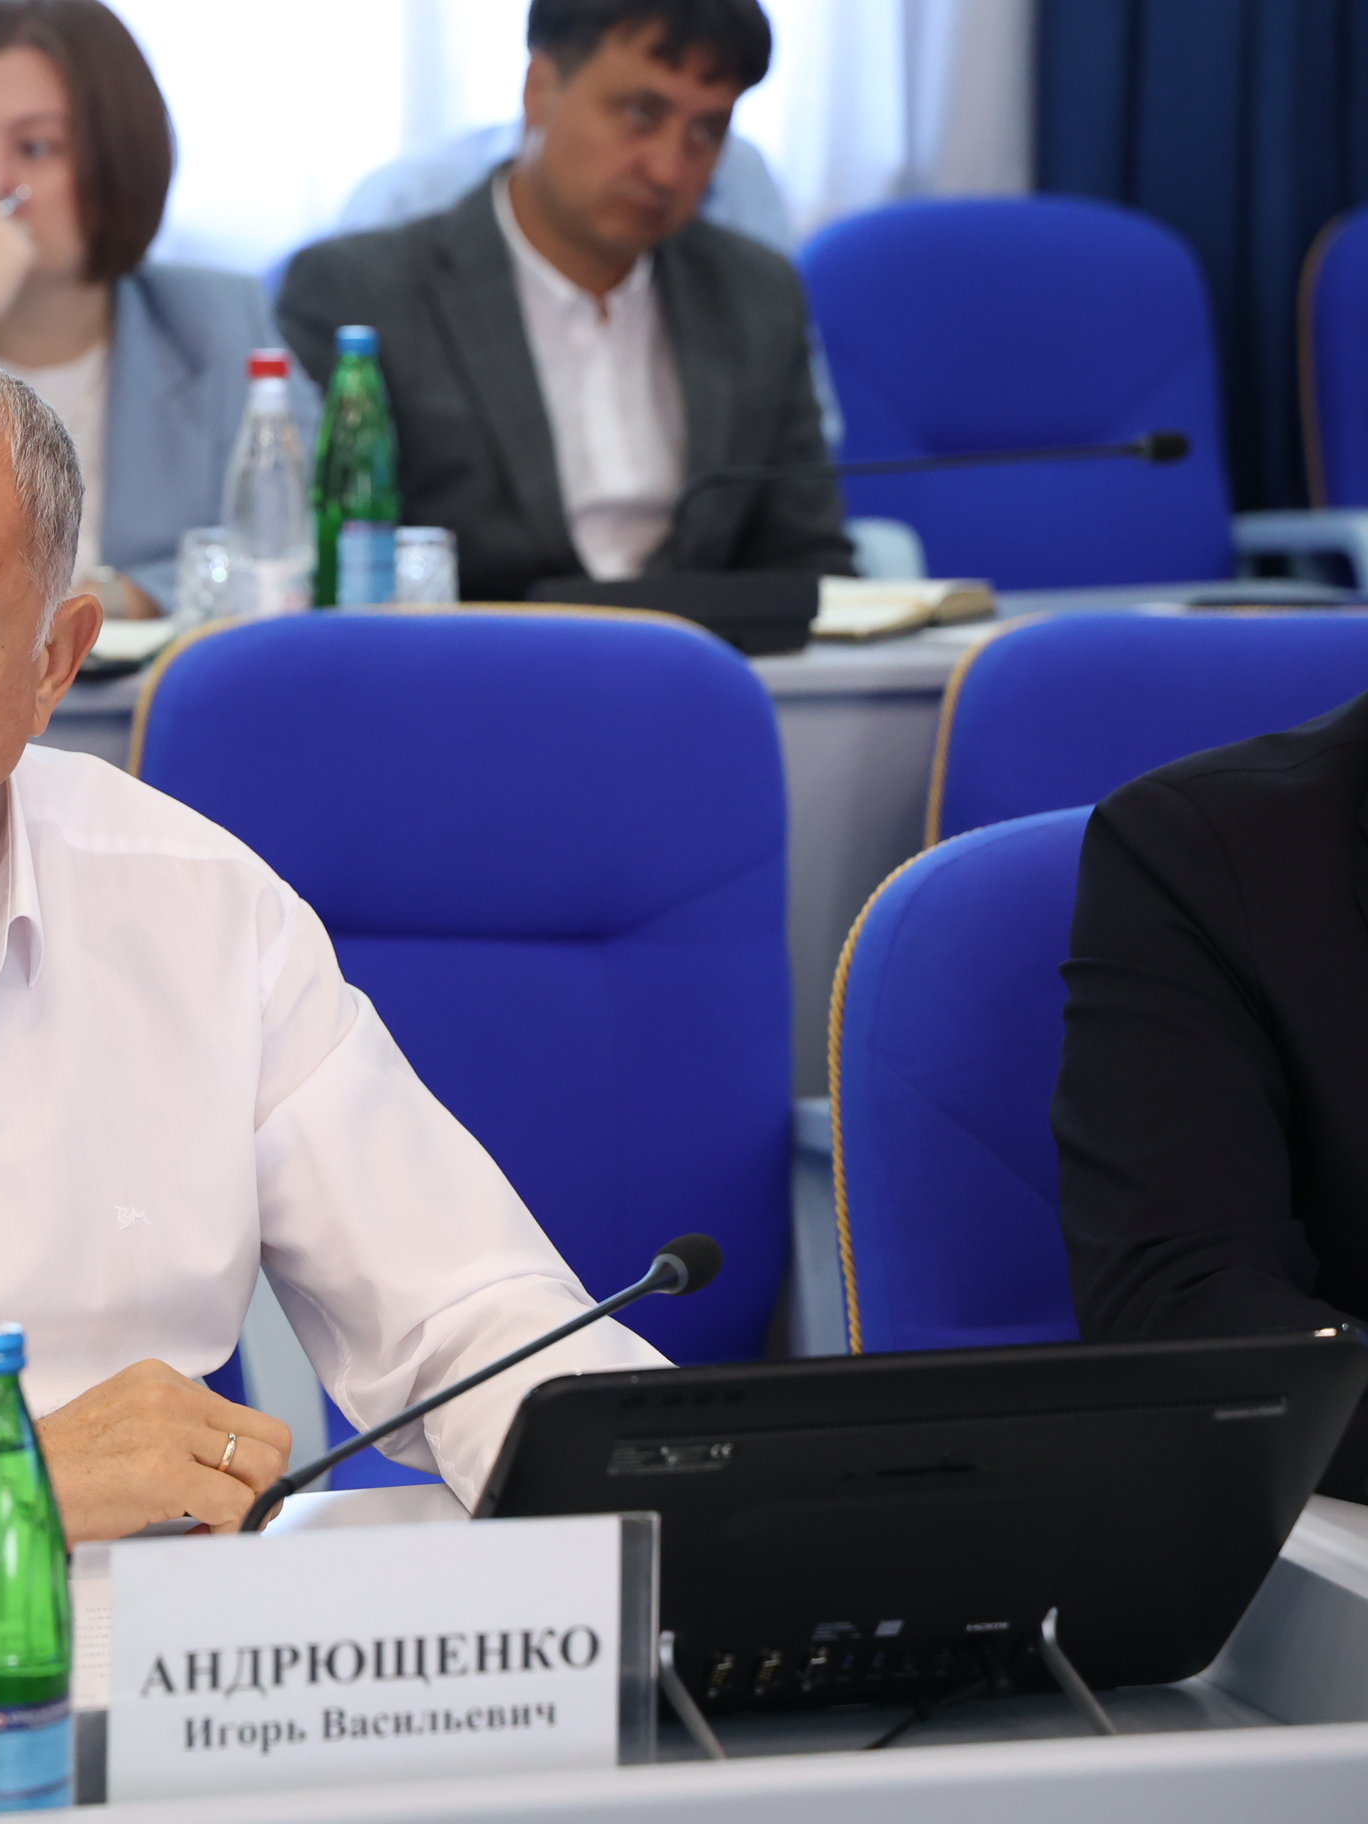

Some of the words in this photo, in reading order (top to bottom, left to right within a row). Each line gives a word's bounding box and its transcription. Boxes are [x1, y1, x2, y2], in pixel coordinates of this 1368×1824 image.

[141, 1624, 601, 1697] АНДРЮЩЕНКО
[183, 1715, 306, 1755] Игорь
[321, 1702, 557, 1742] Васильевич
